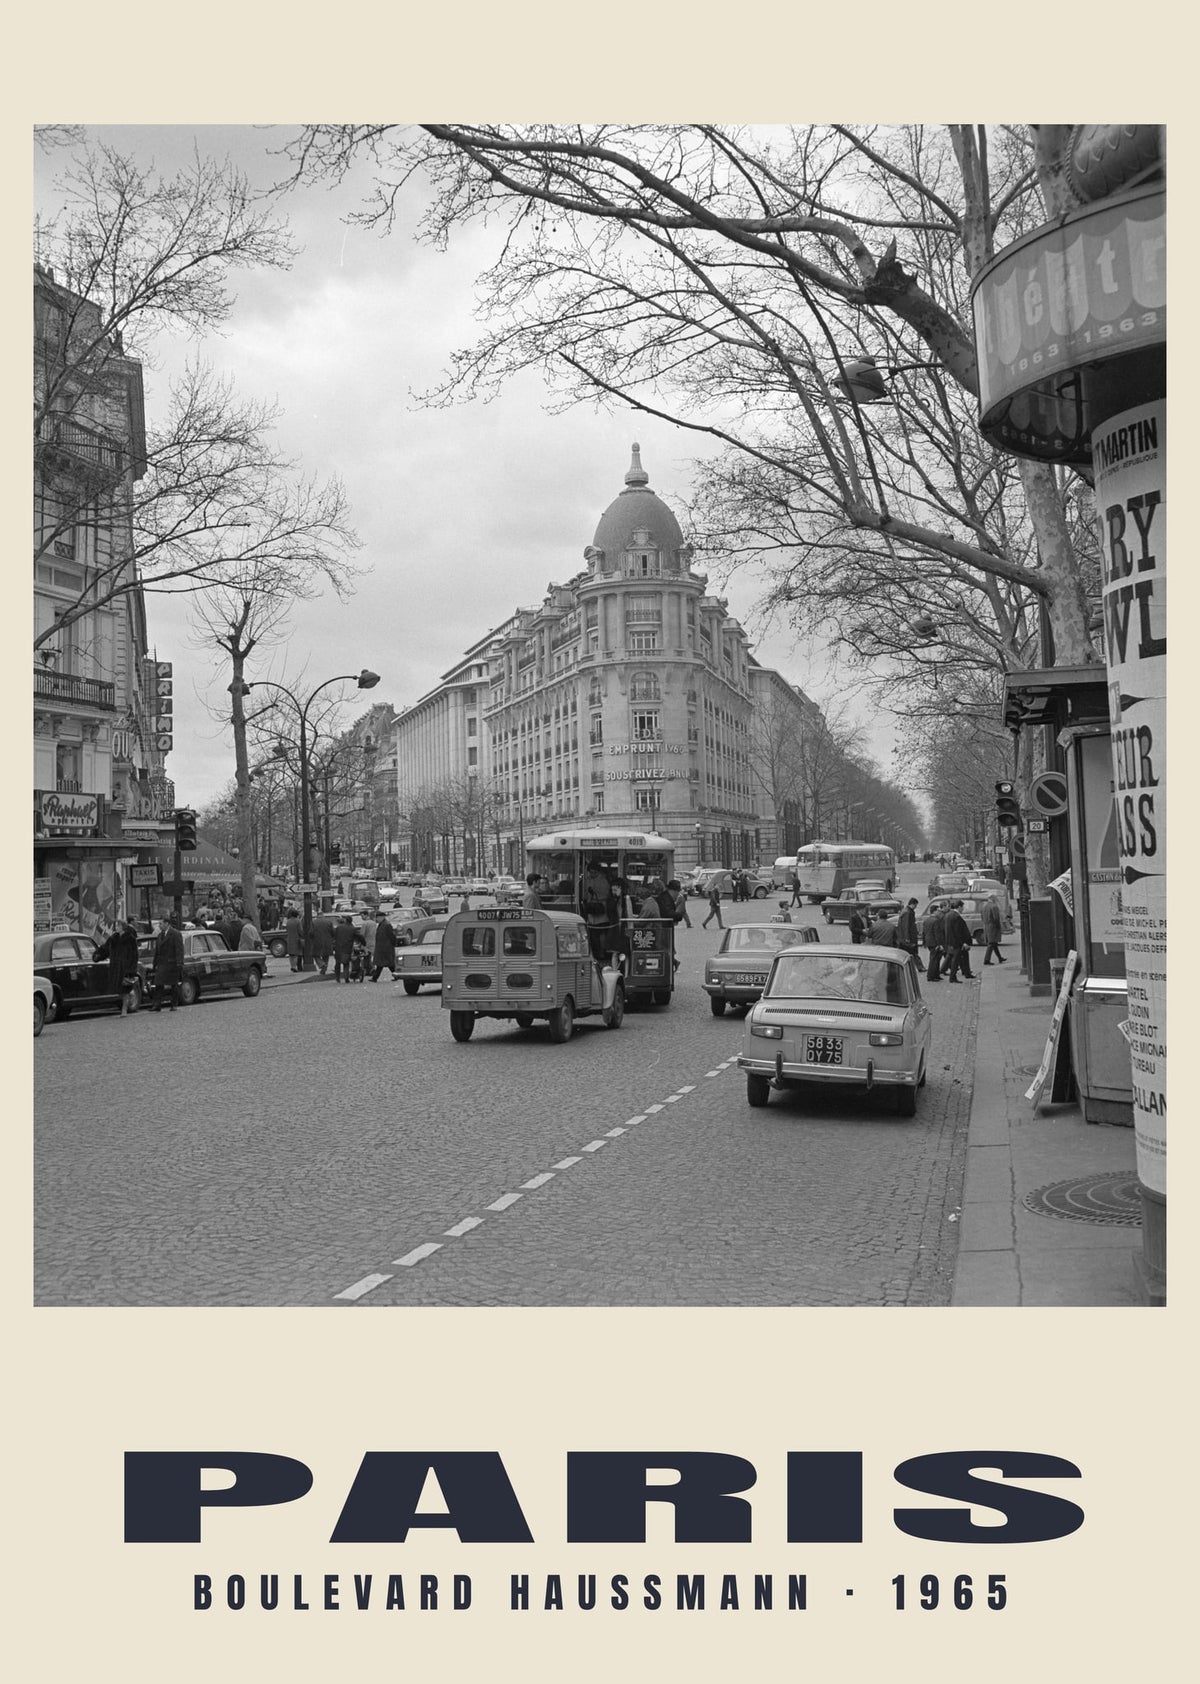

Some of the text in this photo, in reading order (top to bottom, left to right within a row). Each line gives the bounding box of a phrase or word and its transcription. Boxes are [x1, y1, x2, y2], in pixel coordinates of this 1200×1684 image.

[1083, 311, 1158, 343] 1963
[1101, 417, 1158, 469] MARTIN
[609, 743, 662, 755] EMPRUNT
[606, 769, 665, 780] SOUSCRIVEZ
[1032, 820, 1042, 830] 20
[167, 857, 226, 865] CRDINAL
[1140, 1023, 1158, 1038] BLOT
[826, 1051, 842, 1063] 75
